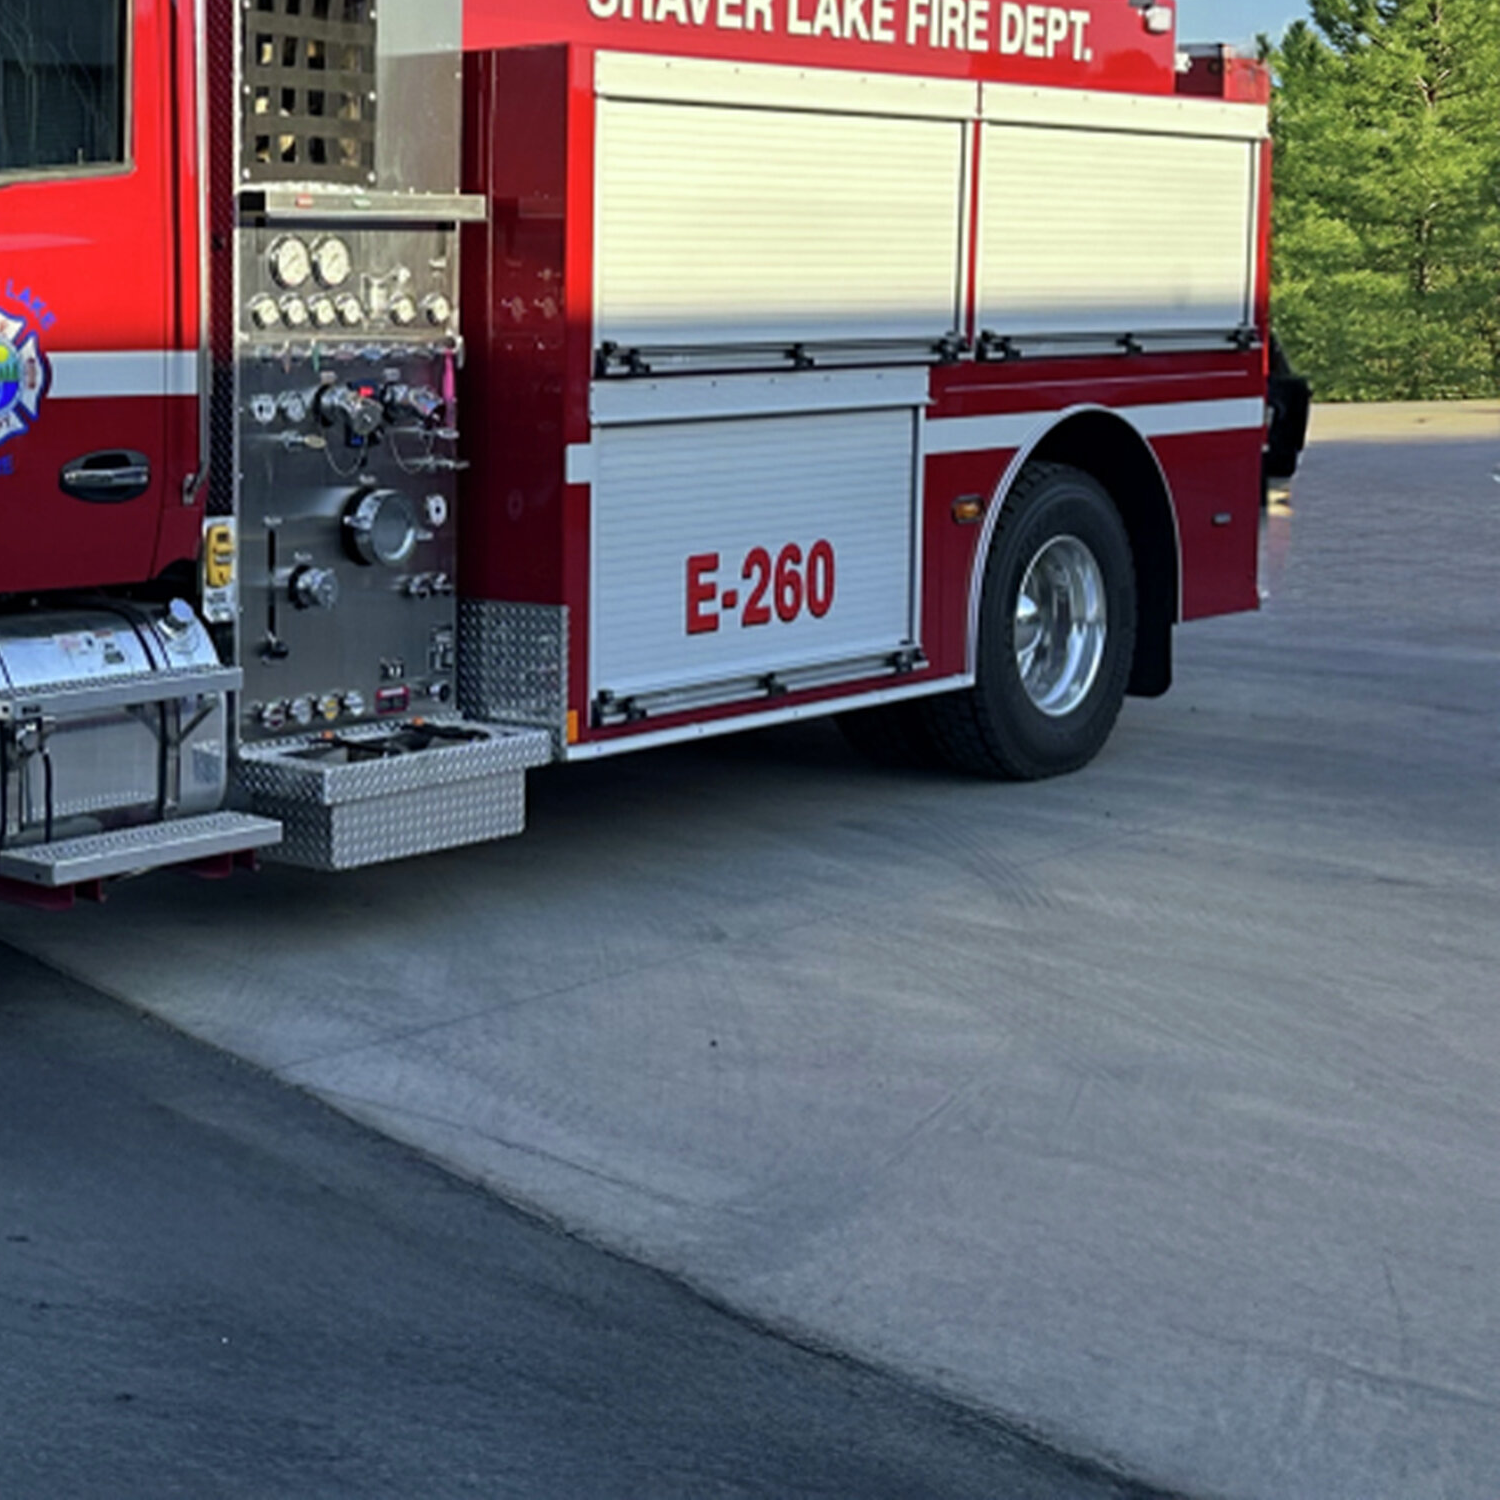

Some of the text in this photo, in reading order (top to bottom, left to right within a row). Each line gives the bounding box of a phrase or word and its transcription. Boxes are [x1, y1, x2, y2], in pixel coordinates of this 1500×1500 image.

[1000, 2, 1092, 62] DEPT.
[6, 278, 57, 332] LAKE
[686, 538, 835, 636] E-260
